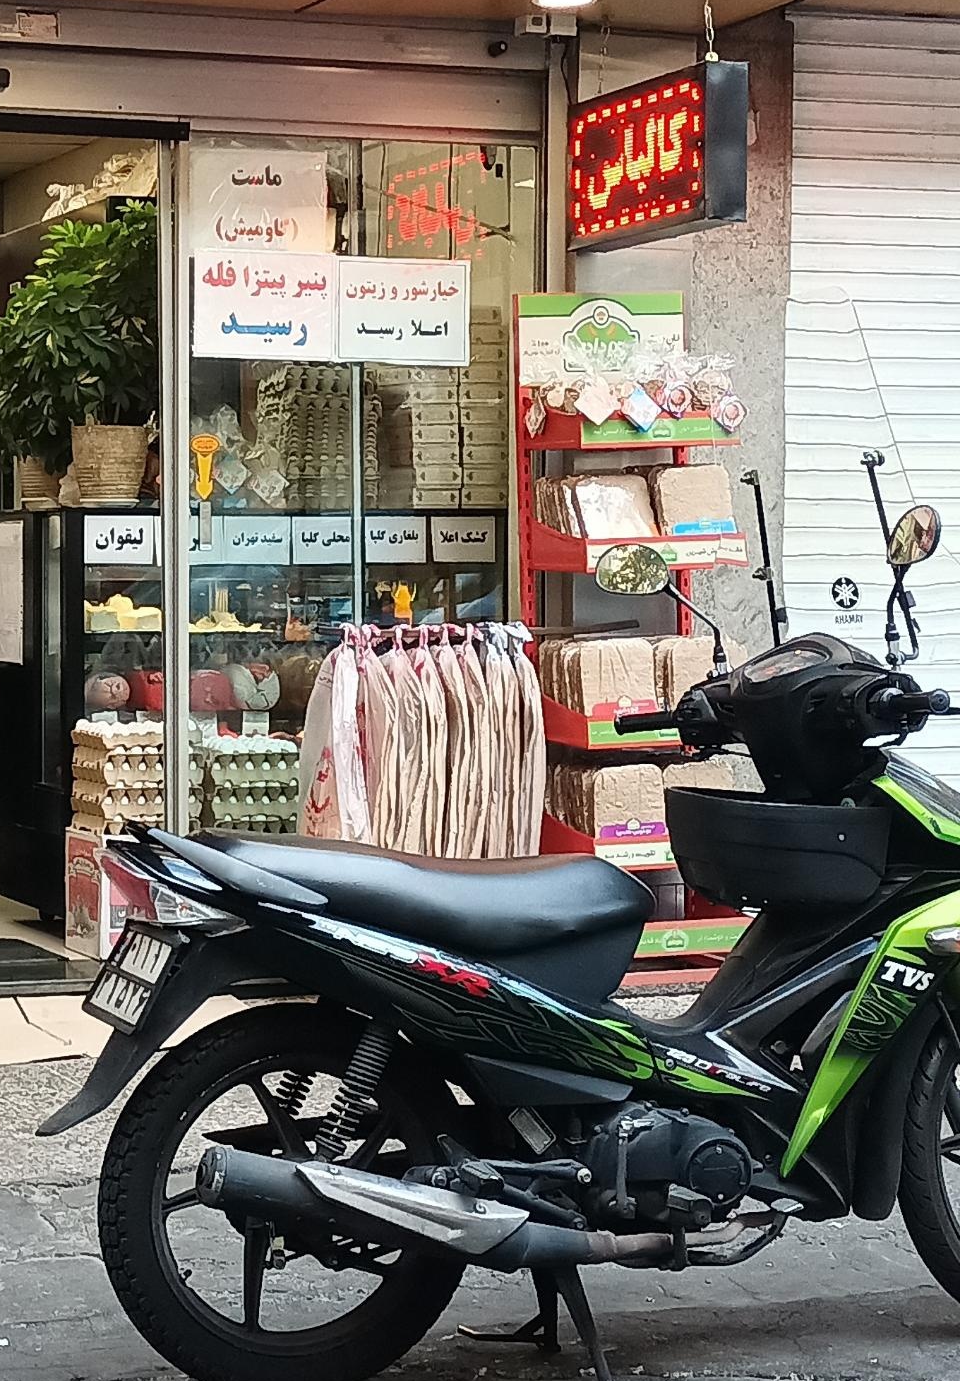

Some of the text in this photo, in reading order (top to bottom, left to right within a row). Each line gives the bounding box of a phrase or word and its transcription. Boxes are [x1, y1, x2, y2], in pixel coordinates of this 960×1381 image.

[587, 106, 688, 210] کالباس
[231, 164, 282, 186] ماست
[202, 259, 327, 300] پنیر پیتزا فله
[345, 280, 386, 300] زیتون
[390, 285, 398, 300] و
[221, 312, 307, 346] رسید
[357, 319, 448, 340] اعلا رسید
[95, 527, 144, 550] لیقوان
[232, 532, 260, 546] تهران
[321, 532, 351, 547] محلی
[440, 530, 488, 544] کشک اعلا
[881, 960, 935, 991] TVS
